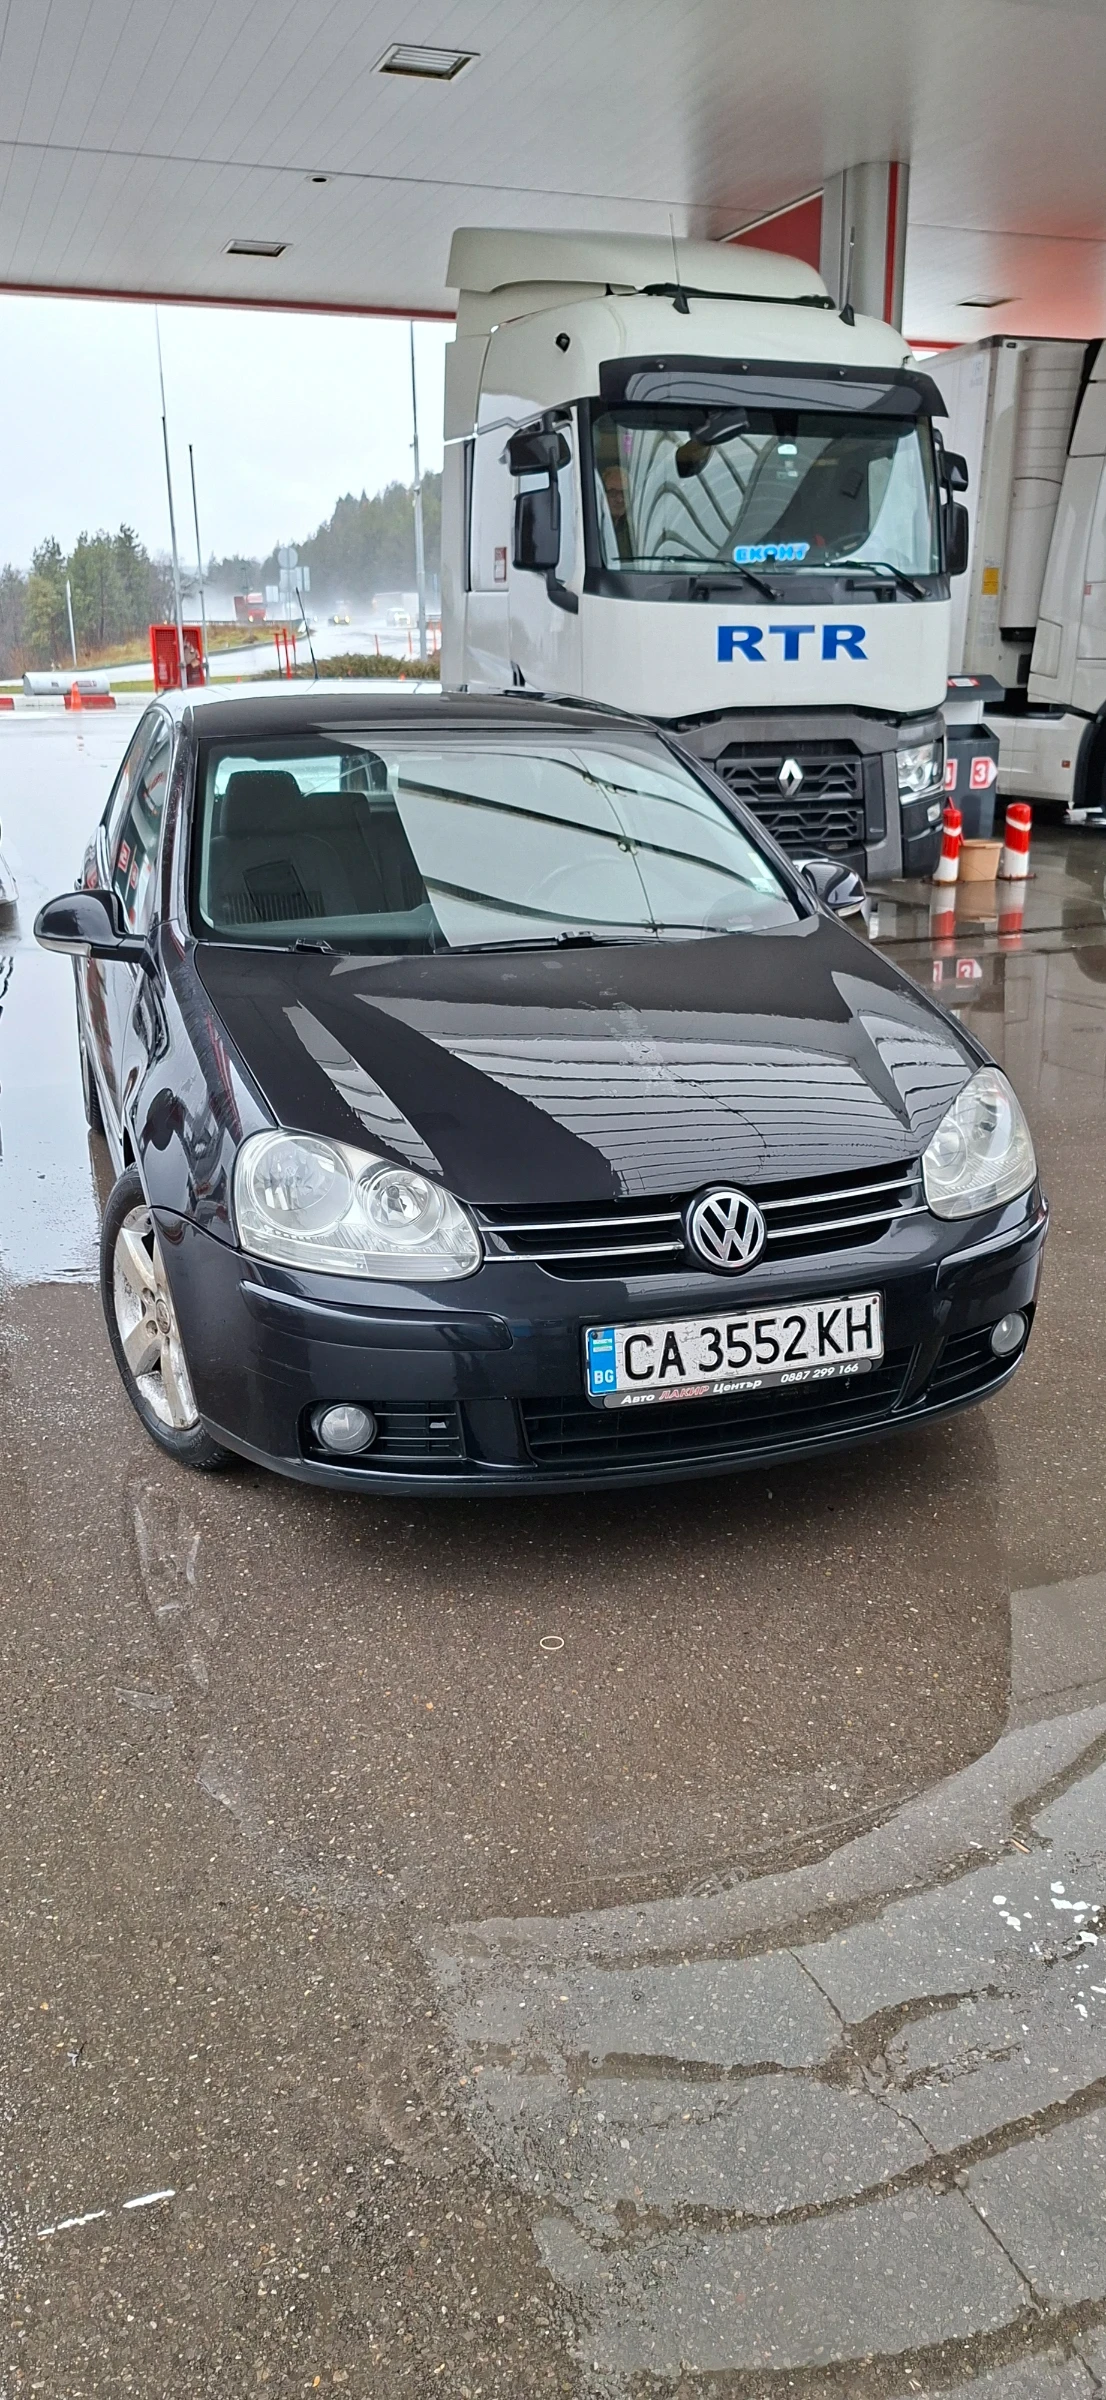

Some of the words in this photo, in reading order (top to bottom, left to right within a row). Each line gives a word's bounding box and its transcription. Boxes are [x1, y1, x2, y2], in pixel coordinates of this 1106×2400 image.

[717, 624, 869, 662] RTR
[974, 763, 986, 782] 3
[694, 1192, 763, 1267] VW
[624, 1331, 686, 1380] CA
[700, 1315, 809, 1372] 3552
[818, 1304, 873, 1356] KH
[594, 1369, 614, 1385] BG
[621, 1394, 655, 1404] Авто
[713, 1380, 762, 1394] Център
[780, 1370, 811, 1383] 0887
[812, 1367, 835, 1378] 299
[839, 1363, 859, 1374] 166
